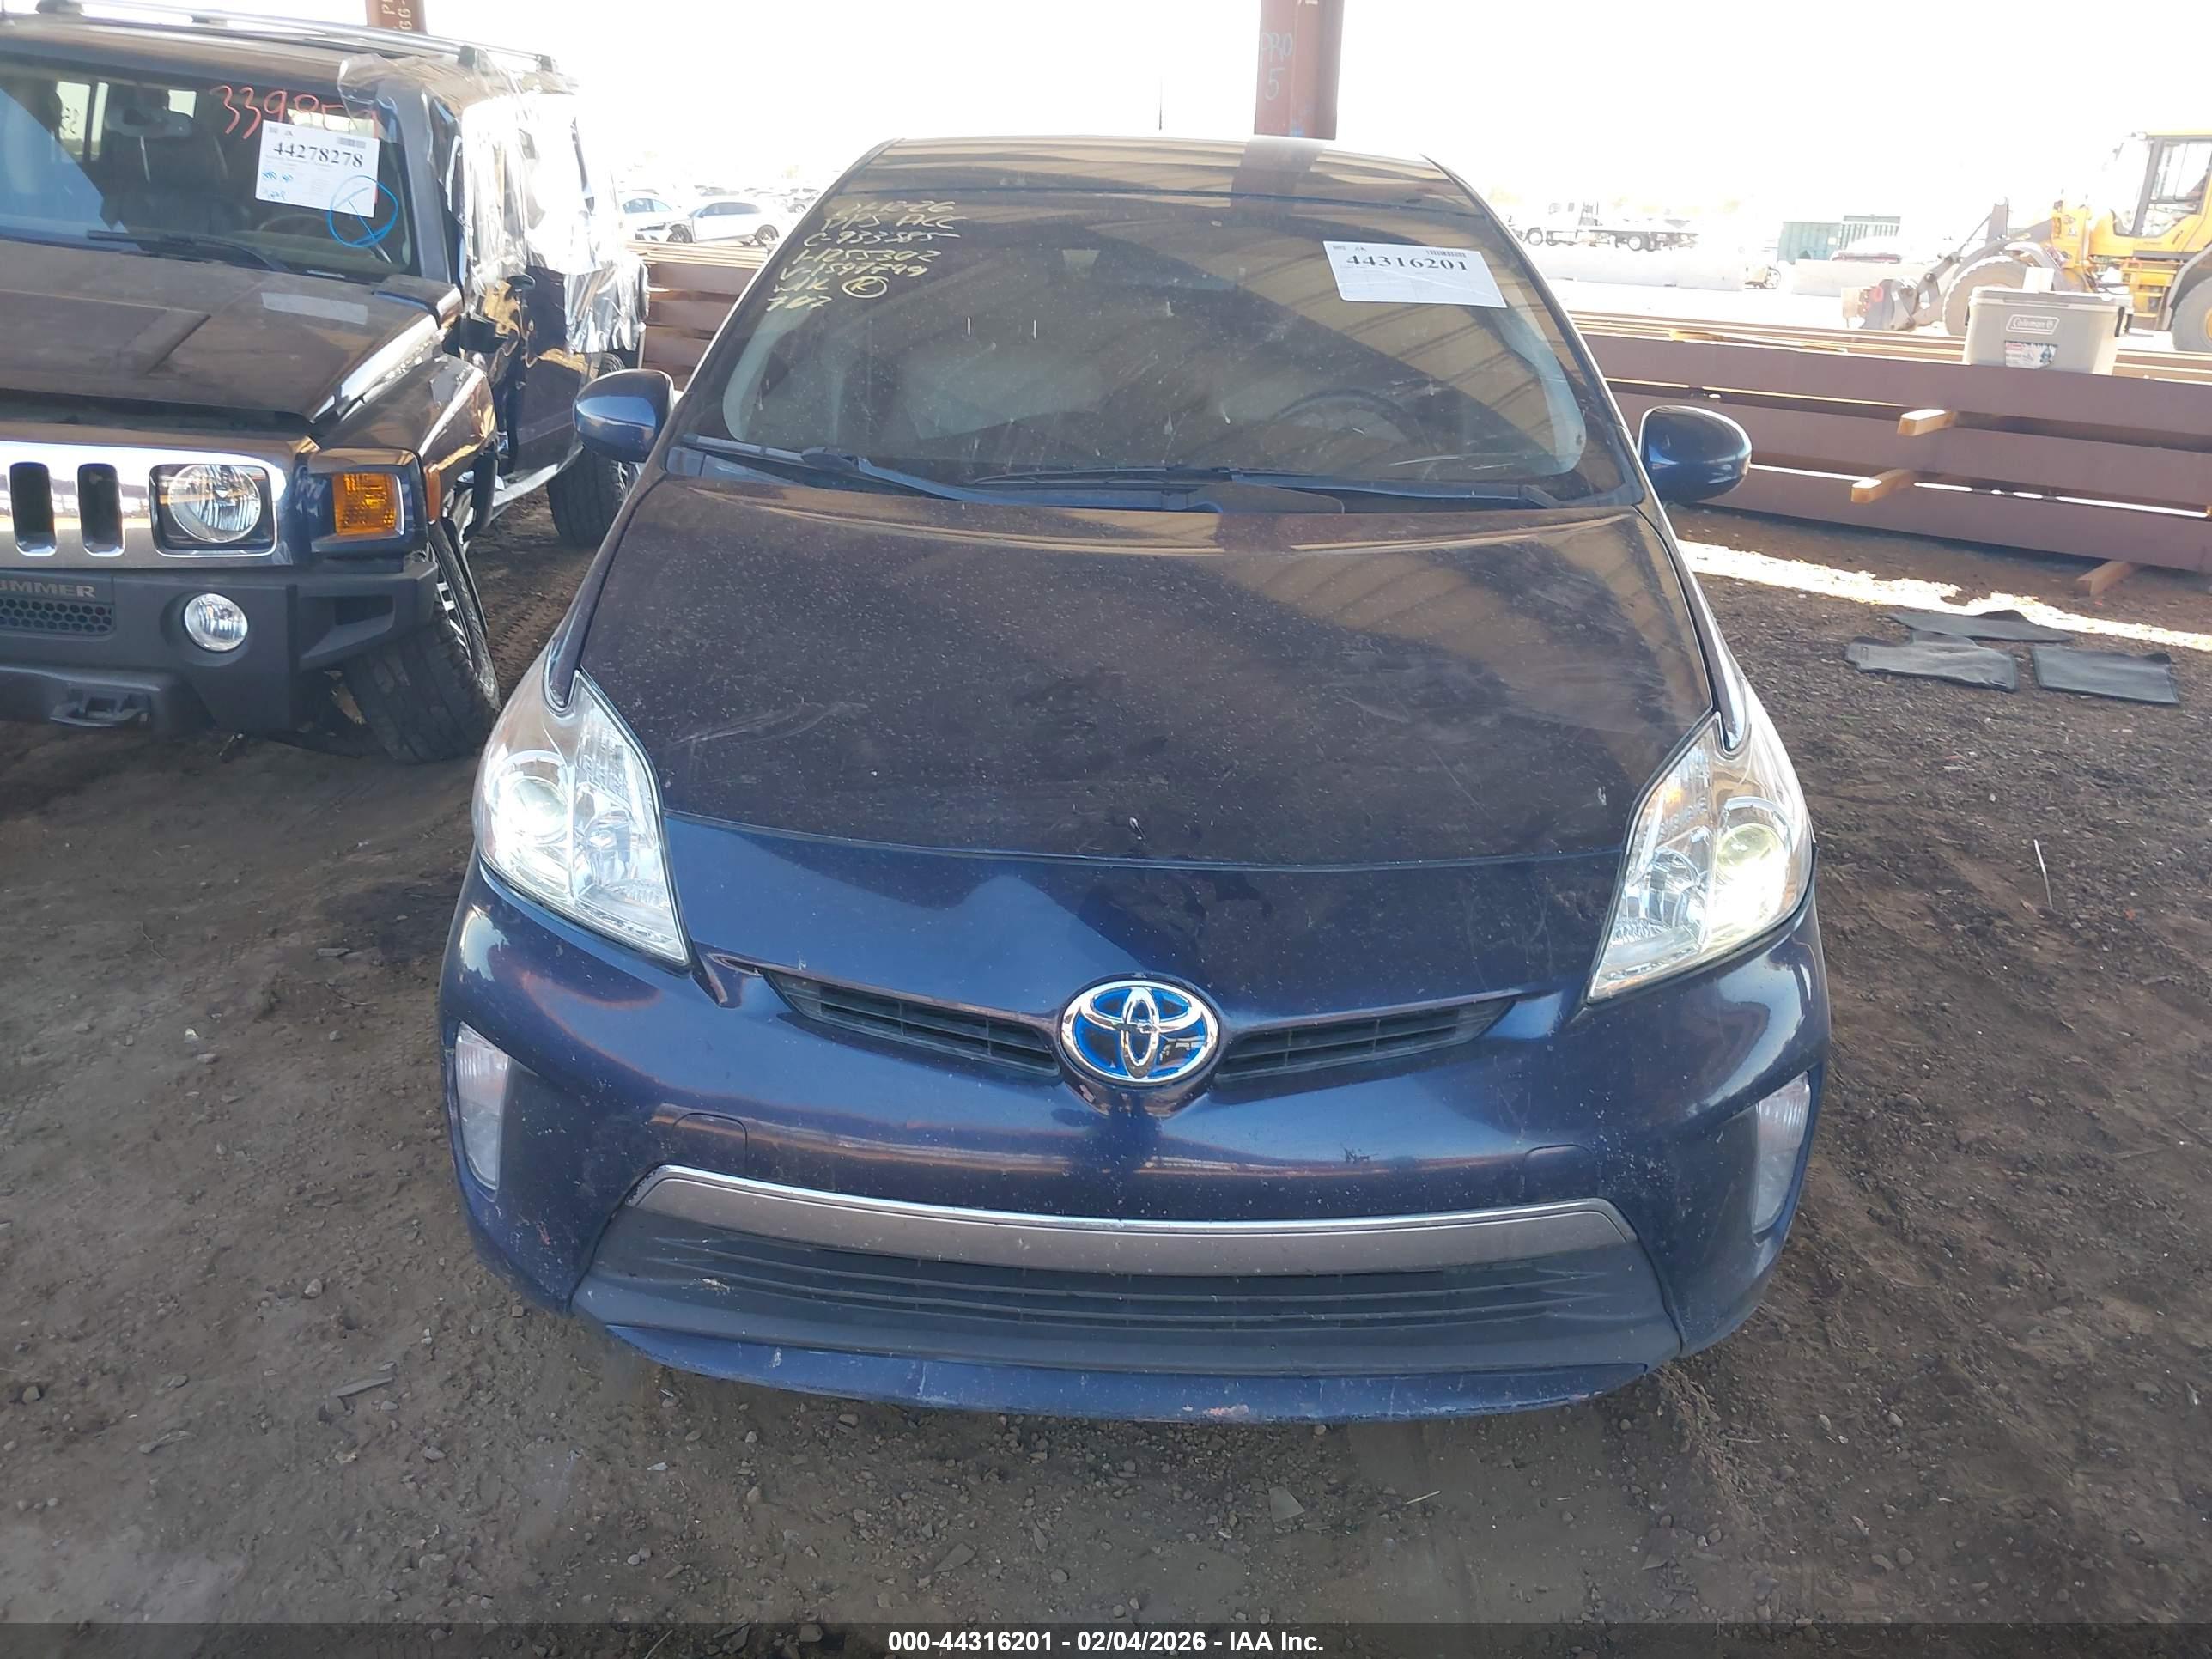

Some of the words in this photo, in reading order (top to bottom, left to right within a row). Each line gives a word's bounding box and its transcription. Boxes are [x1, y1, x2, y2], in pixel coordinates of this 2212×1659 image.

[1265, 67, 1285, 101] 5
[273, 141, 364, 168] 44278278
[1346, 254, 1469, 272] 44316201
